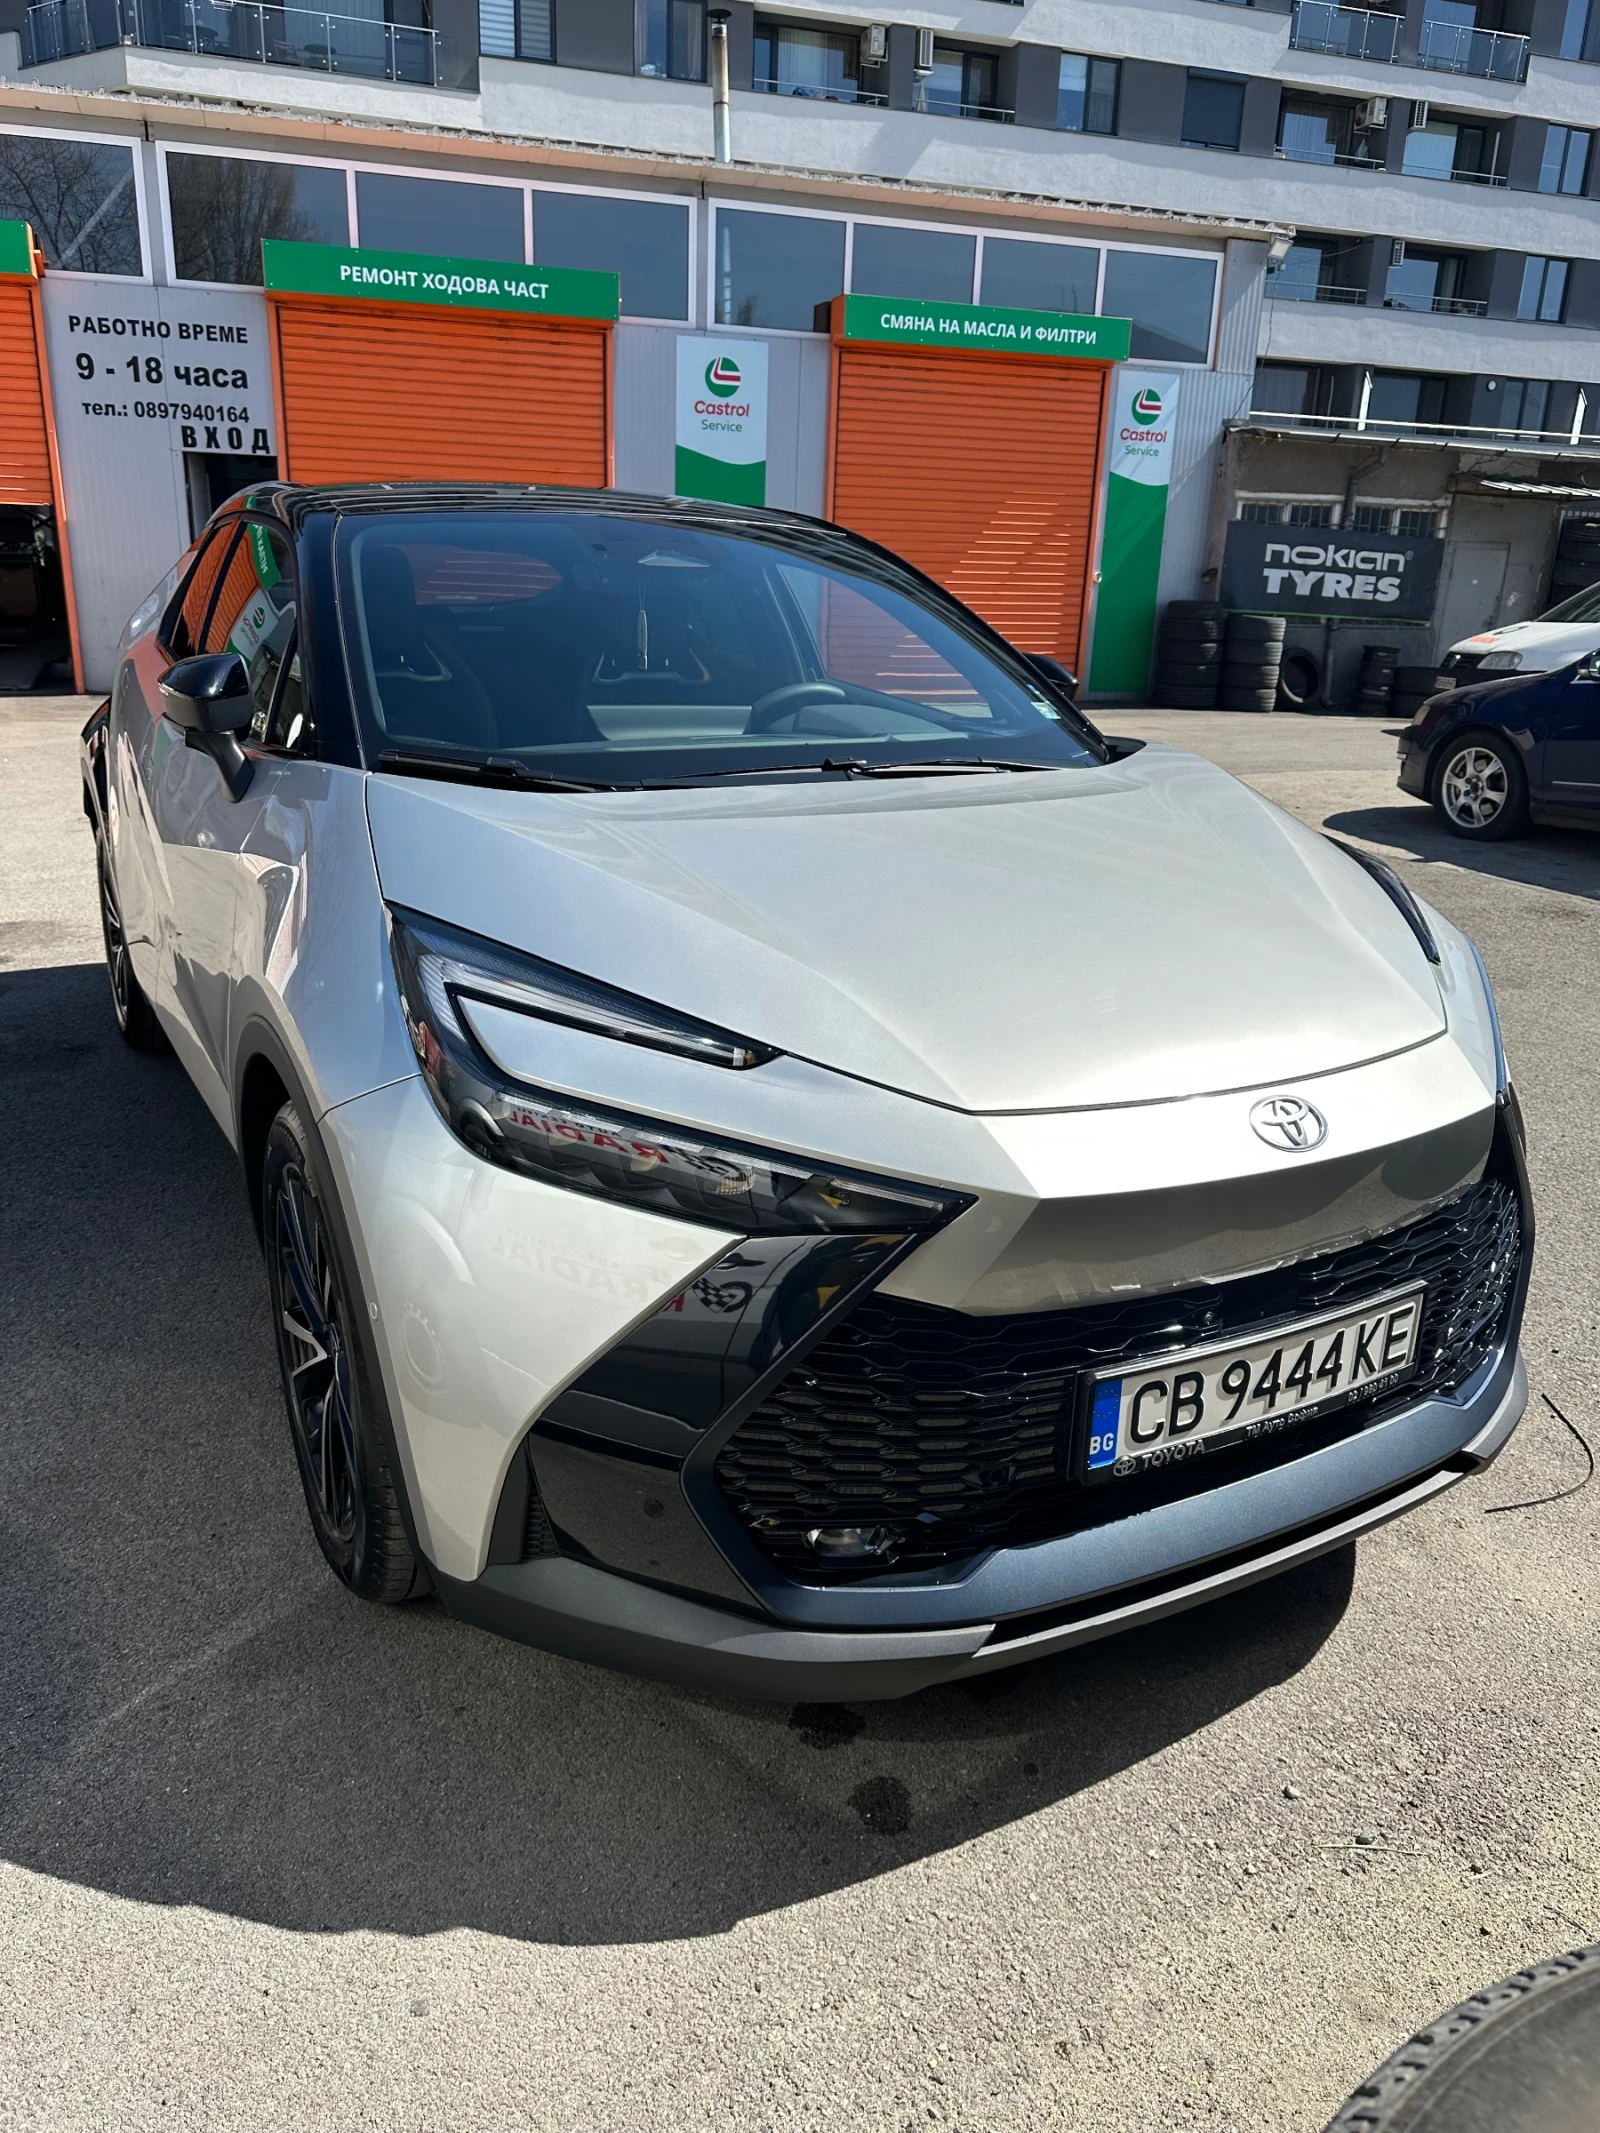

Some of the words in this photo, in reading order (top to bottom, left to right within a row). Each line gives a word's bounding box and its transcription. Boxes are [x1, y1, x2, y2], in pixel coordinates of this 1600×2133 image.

[340, 264, 418, 287] РЕМОНТ
[422, 272, 501, 295] ХОДОВА
[503, 280, 549, 299] ЧАСТ
[68, 315, 171, 339] РАБОТНО
[178, 322, 249, 344] ВРЕМЕ
[880, 313, 935, 332] СМЯНА
[939, 319, 960, 334] НА
[963, 320, 1017, 339] МАСЛА
[1020, 325, 1032, 339] И
[1035, 326, 1097, 345] ФИЛТРИ
[75, 352, 95, 380] 9
[105, 366, 115, 375] -
[126, 355, 163, 384] 18
[174, 365, 249, 389] часа
[82, 402, 128, 417] тел.:
[134, 401, 250, 423] 0897940164
[694, 400, 750, 417] Castrol
[701, 419, 743, 432] Service
[1120, 428, 1167, 443] Castrol
[1125, 445, 1159, 457] Service
[1263, 567, 1402, 603] TYRES
[1130, 1371, 1205, 1444] CB
[1220, 1329, 1346, 1421] 9444
[1351, 1304, 1415, 1381] KE
[1089, 1432, 1115, 1455] BG
[1142, 1439, 1205, 1470] TOYOTA
